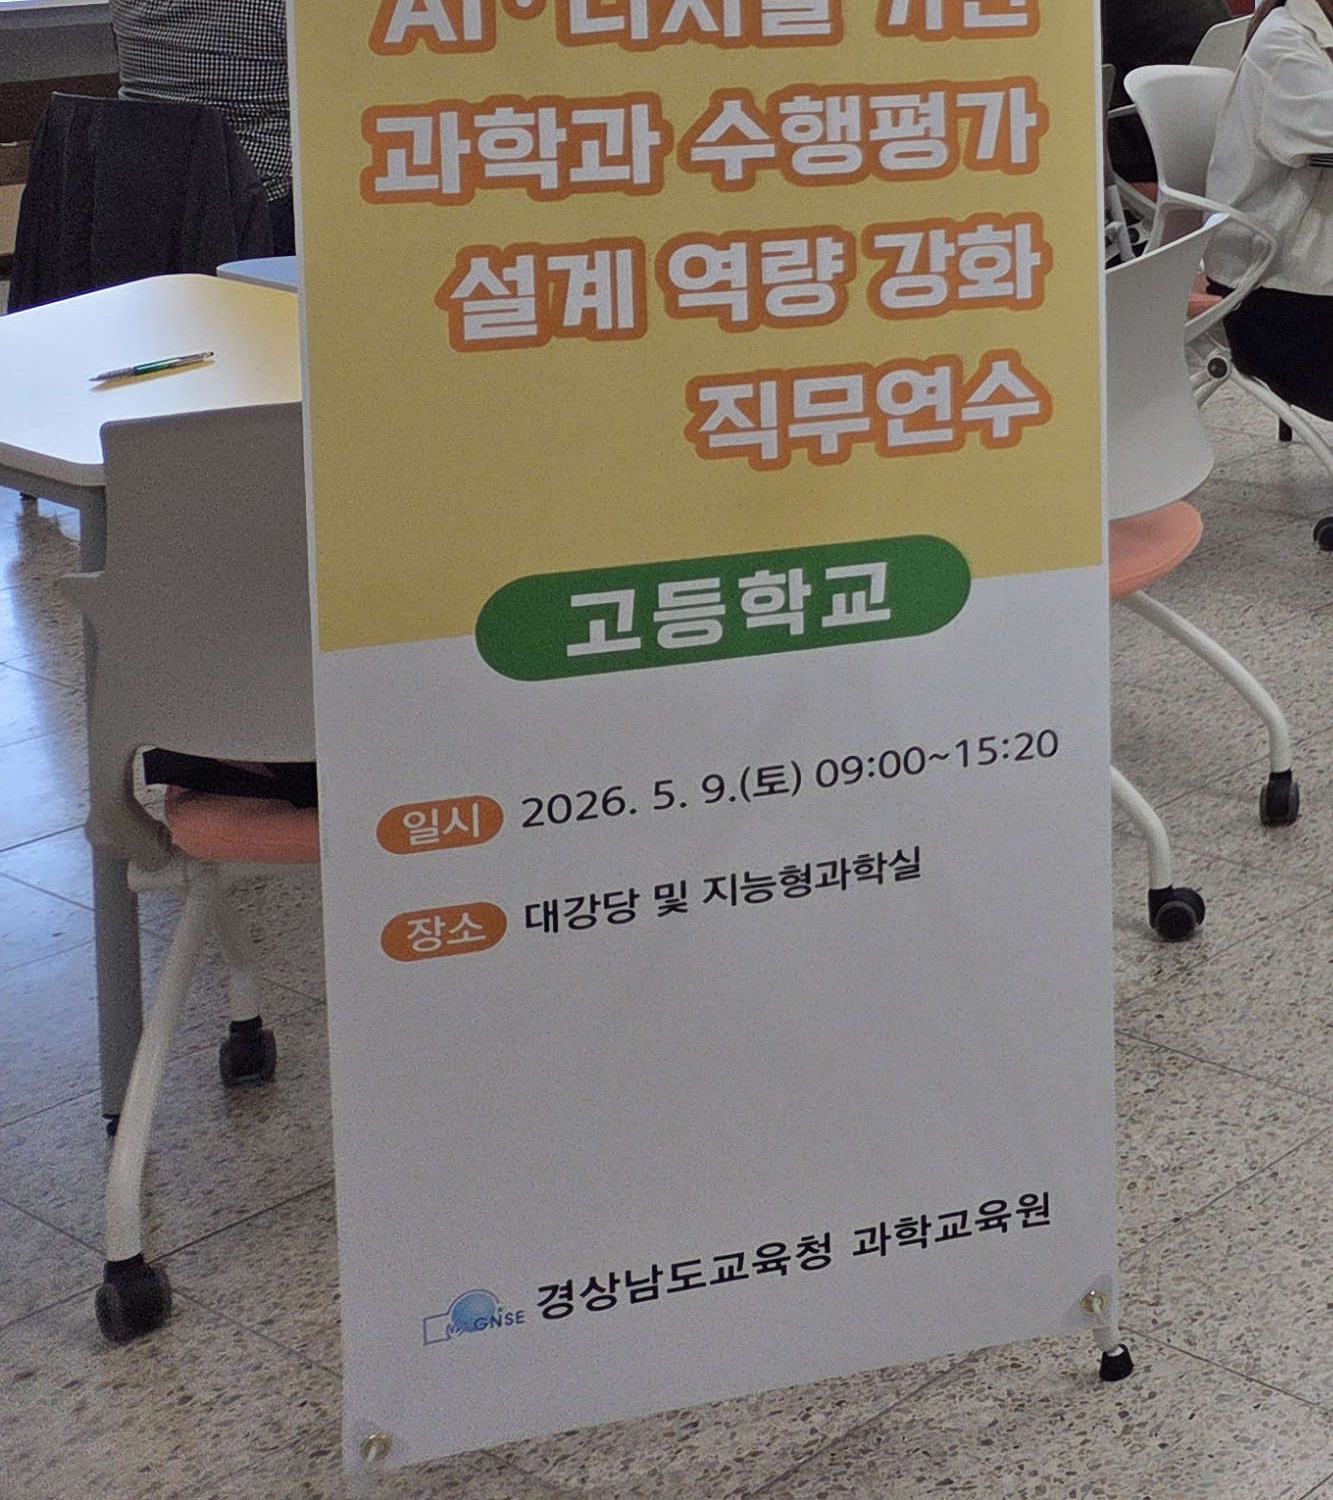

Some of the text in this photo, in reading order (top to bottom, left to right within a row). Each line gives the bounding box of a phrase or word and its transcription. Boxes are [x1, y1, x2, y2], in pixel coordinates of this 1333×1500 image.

[372, 84, 1039, 196] 과학과 수행평가
[448, 221, 1043, 342] 설계 역량 강화
[698, 357, 1043, 461] 직무연수
[565, 560, 893, 658] 고등학교
[401, 800, 482, 846] 일시
[520, 727, 1060, 830] 2026. 5. 9.(토) 09:00~15:20
[405, 910, 488, 953] 장소
[523, 844, 924, 935] 대강당 및 지능형과학실
[535, 1189, 1053, 1321] 경상남도교육청 과학교육원
